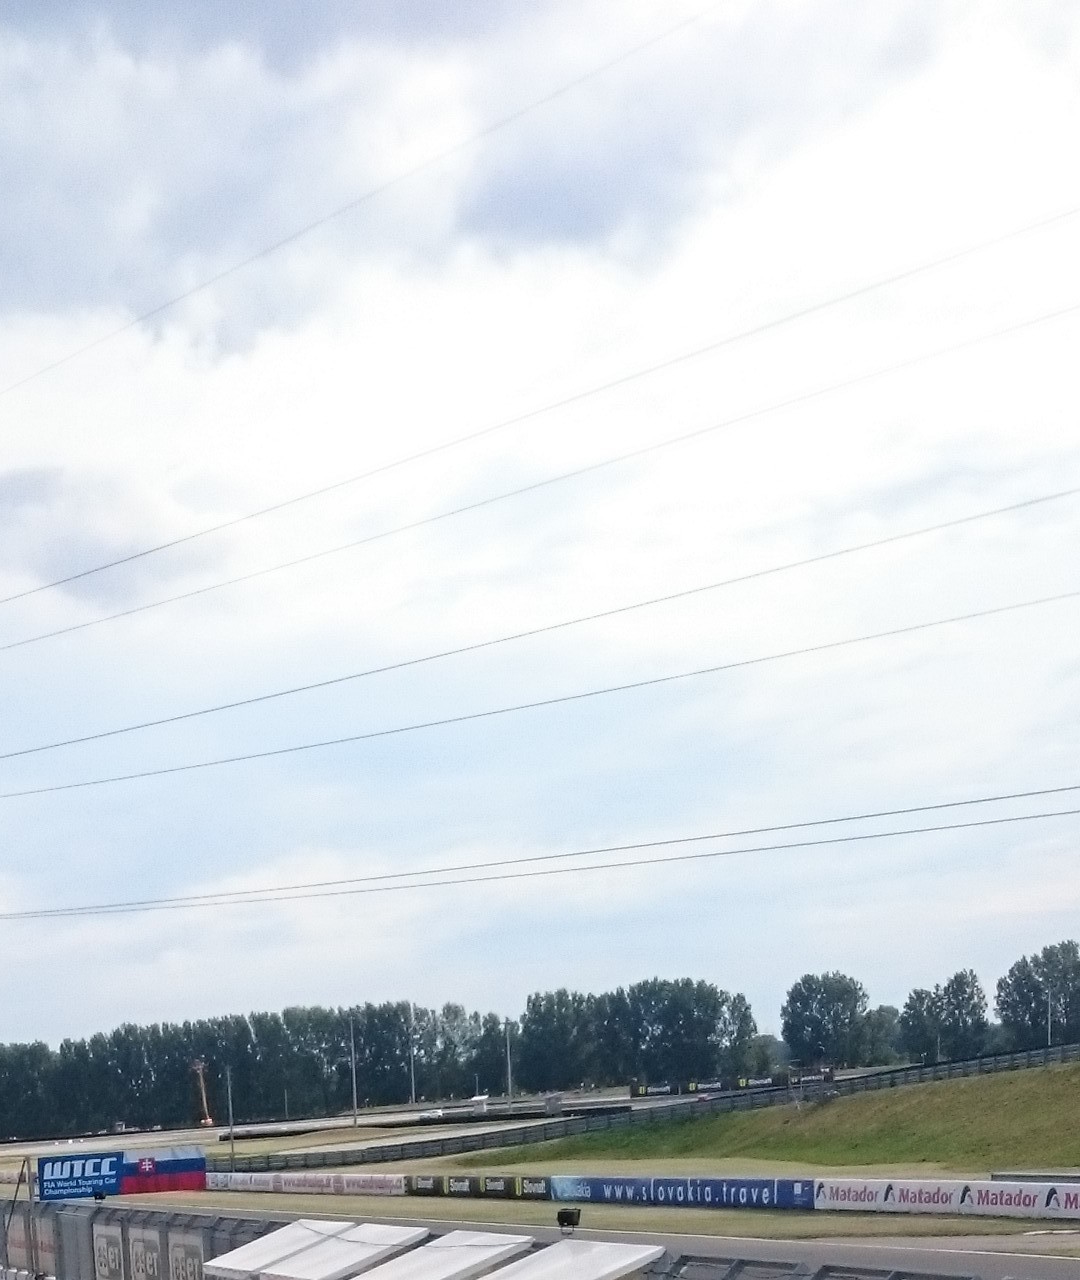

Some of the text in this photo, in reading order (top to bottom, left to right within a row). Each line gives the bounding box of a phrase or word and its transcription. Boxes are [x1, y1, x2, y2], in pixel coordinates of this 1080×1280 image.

[43, 1157, 117, 1180] WTCC
[43, 1177, 117, 1189] FIA World Touring Car
[43, 1186, 93, 1196] Championship
[603, 1178, 778, 1205] www.slovakia.travel
[829, 1185, 879, 1202] Matador
[898, 1187, 953, 1206] Matador
[977, 1189, 1039, 1208] Matador
